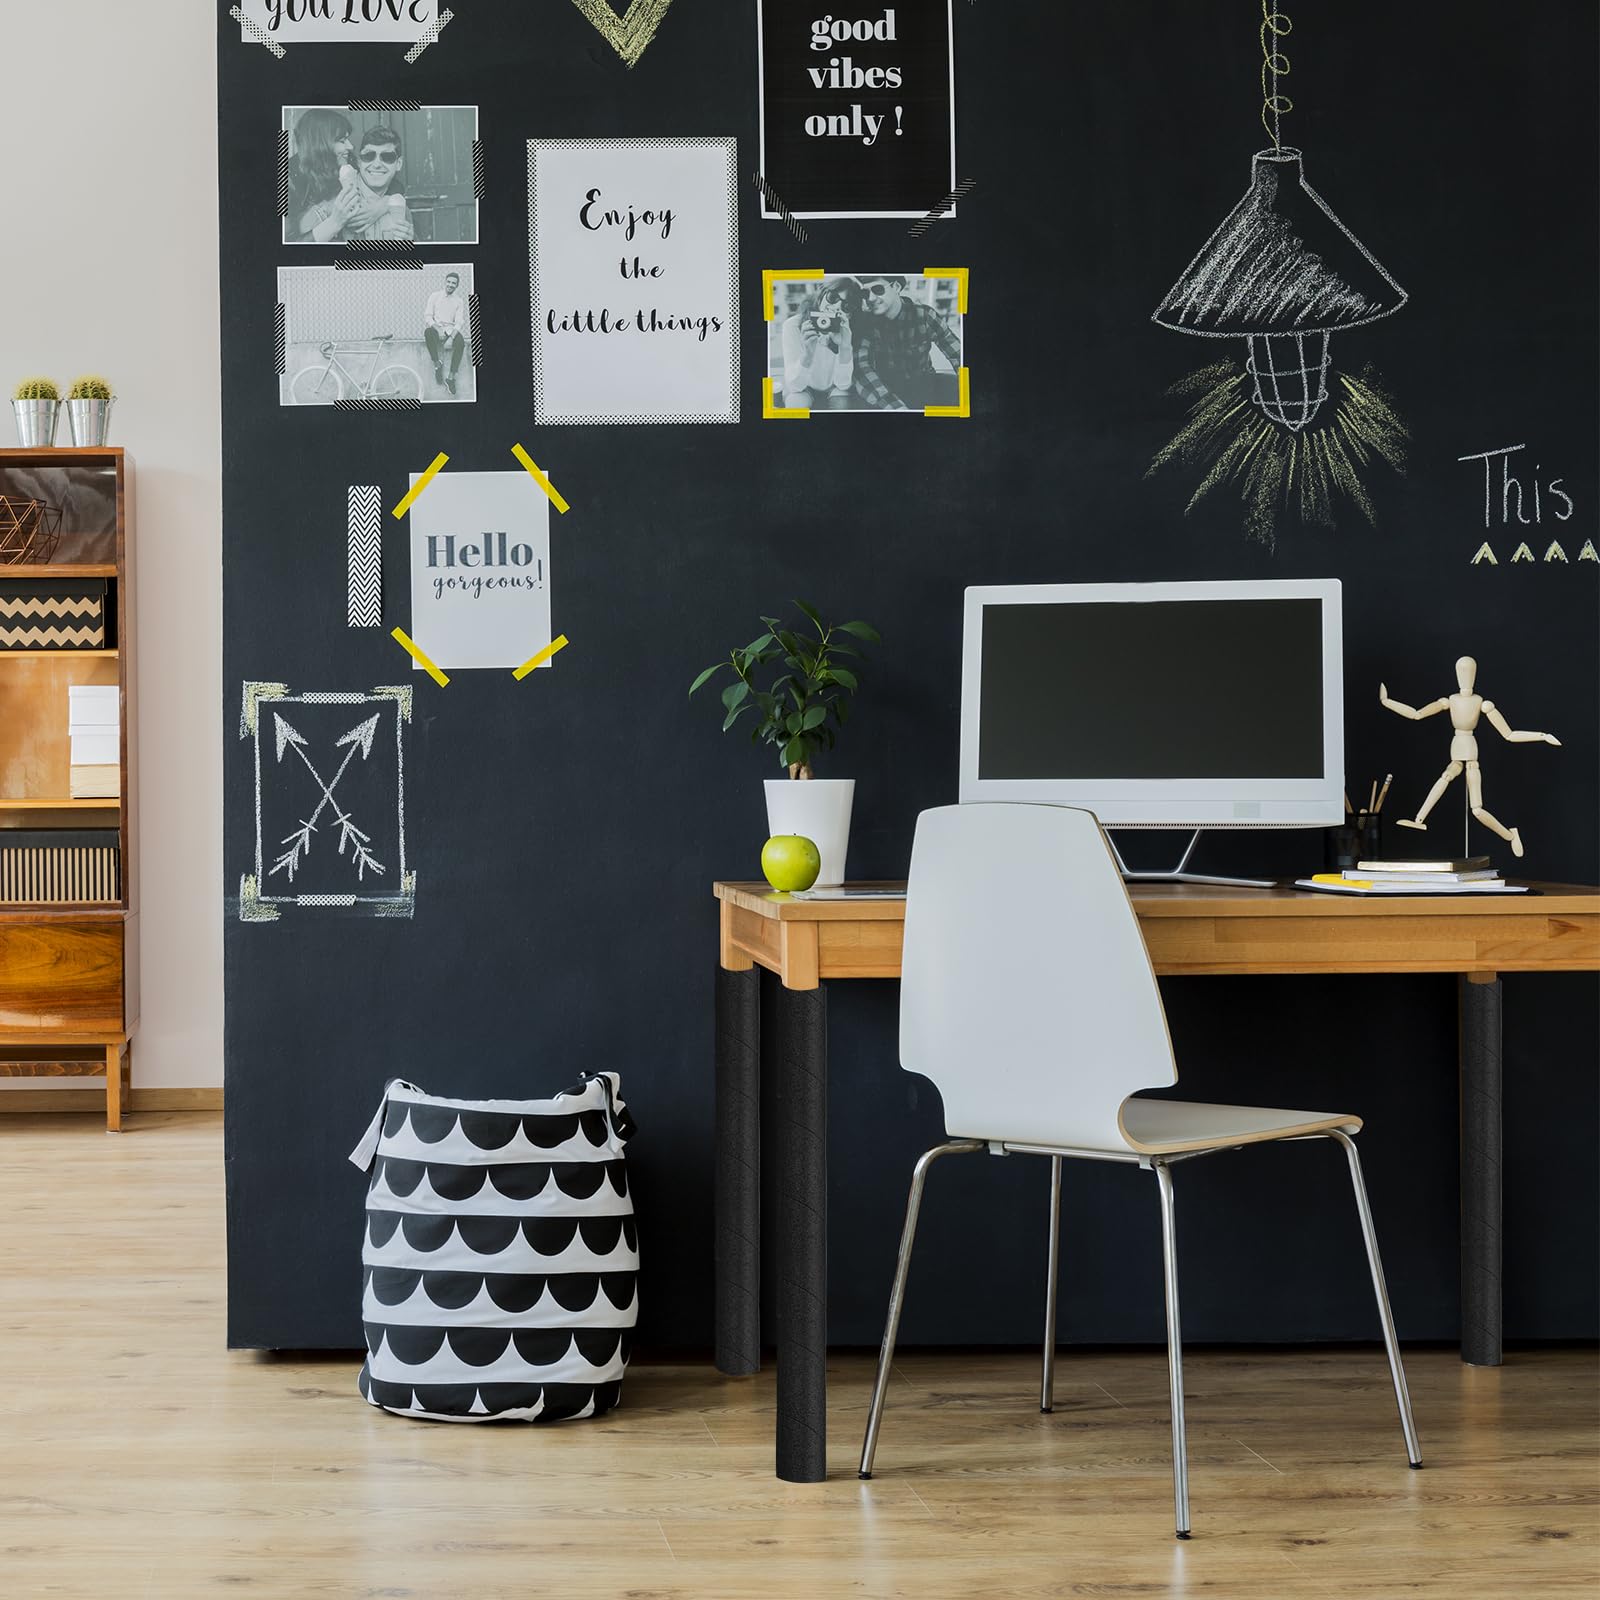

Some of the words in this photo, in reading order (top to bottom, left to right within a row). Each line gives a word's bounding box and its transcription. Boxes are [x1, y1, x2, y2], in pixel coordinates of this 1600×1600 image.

[810, 9, 897, 50] good
[807, 57, 902, 88] vibes
[804, 104, 885, 145] only
[579, 188, 676, 242] Enjoy
[618, 256, 664, 279] the
[547, 308, 630, 334] little
[636, 308, 724, 342] things
[1458, 444, 1573, 527] This
[425, 532, 533, 568] Hello
[433, 558, 543, 600] gorgeous!
